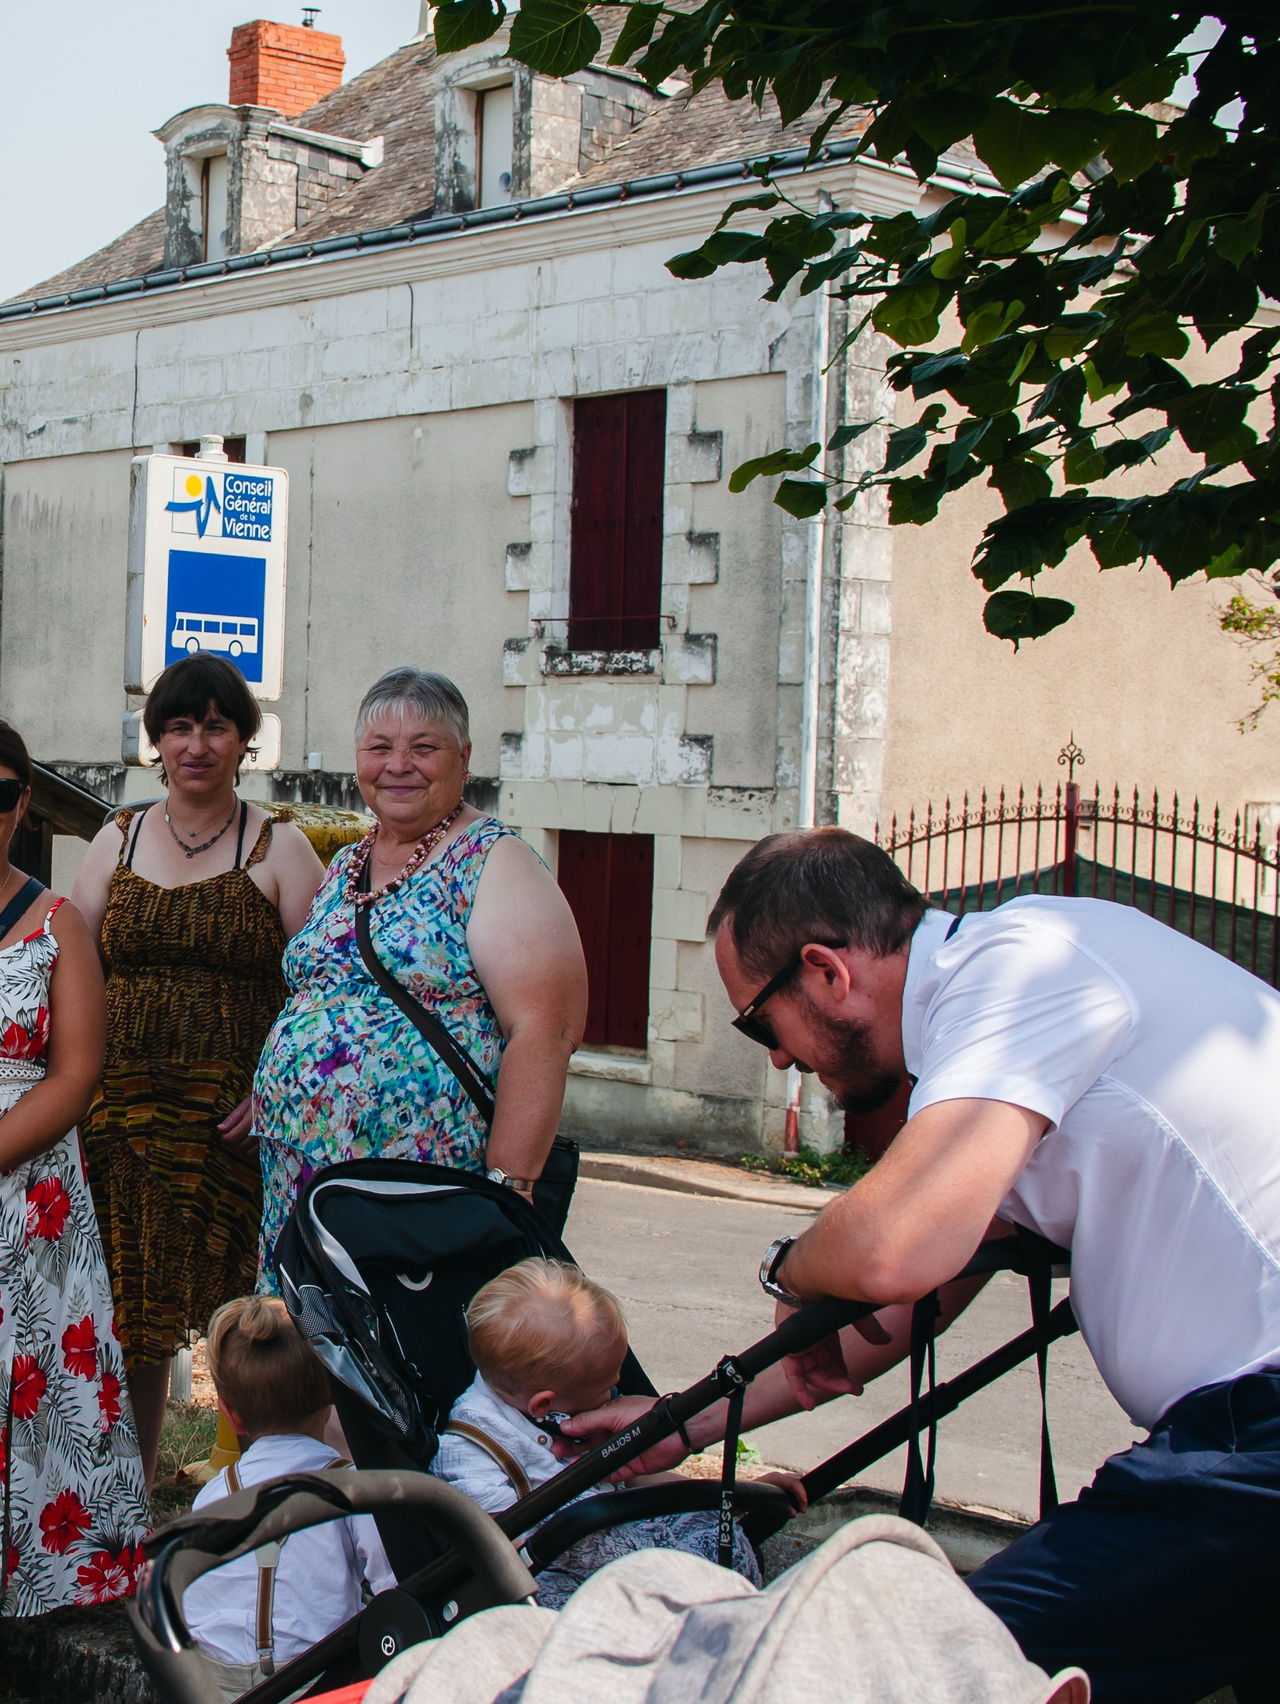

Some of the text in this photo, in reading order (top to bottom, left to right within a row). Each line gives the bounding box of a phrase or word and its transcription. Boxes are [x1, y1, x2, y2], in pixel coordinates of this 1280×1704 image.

[225, 475, 272, 497] Conseil
[224, 494, 271, 515] Général
[224, 516, 270, 539] Vienne
[239, 513, 256, 522] de la
[601, 1425, 641, 1459] BALIOS M
[719, 1490, 734, 1548] Lascal
